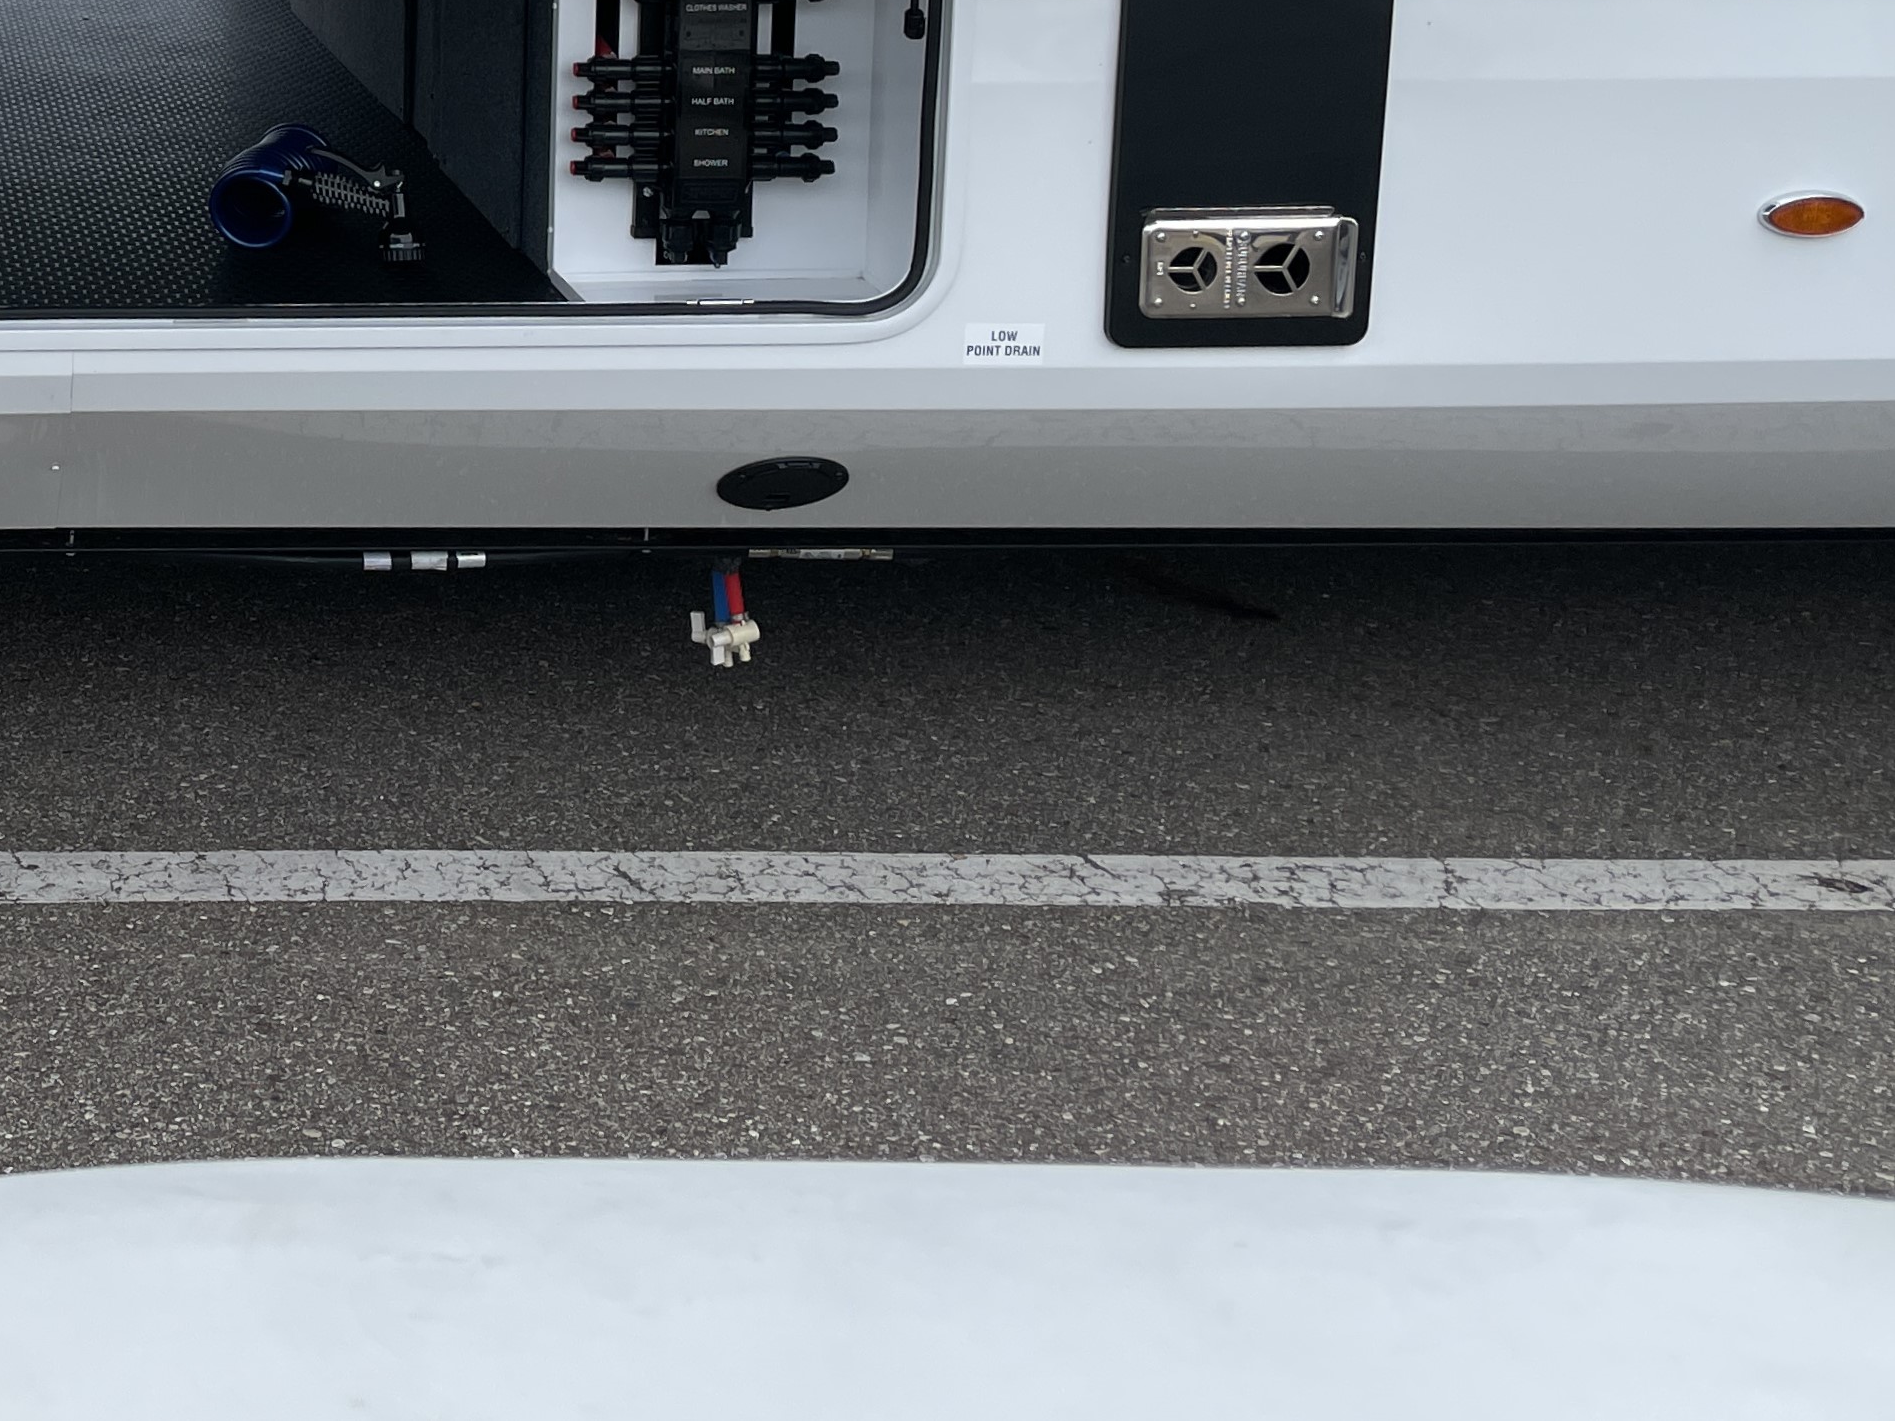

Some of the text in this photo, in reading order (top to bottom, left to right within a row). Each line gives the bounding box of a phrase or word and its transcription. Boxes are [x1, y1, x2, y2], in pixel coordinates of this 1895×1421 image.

[685, 3, 747, 12] CLOTHES WASHER
[692, 66, 736, 75] MAIN BATH
[691, 97, 735, 105] HALF BATH
[694, 128, 729, 137] KITCHEN
[693, 159, 729, 167] SHOWER
[991, 330, 1018, 342] LOW
[966, 345, 1041, 356] POINT DRAIN
